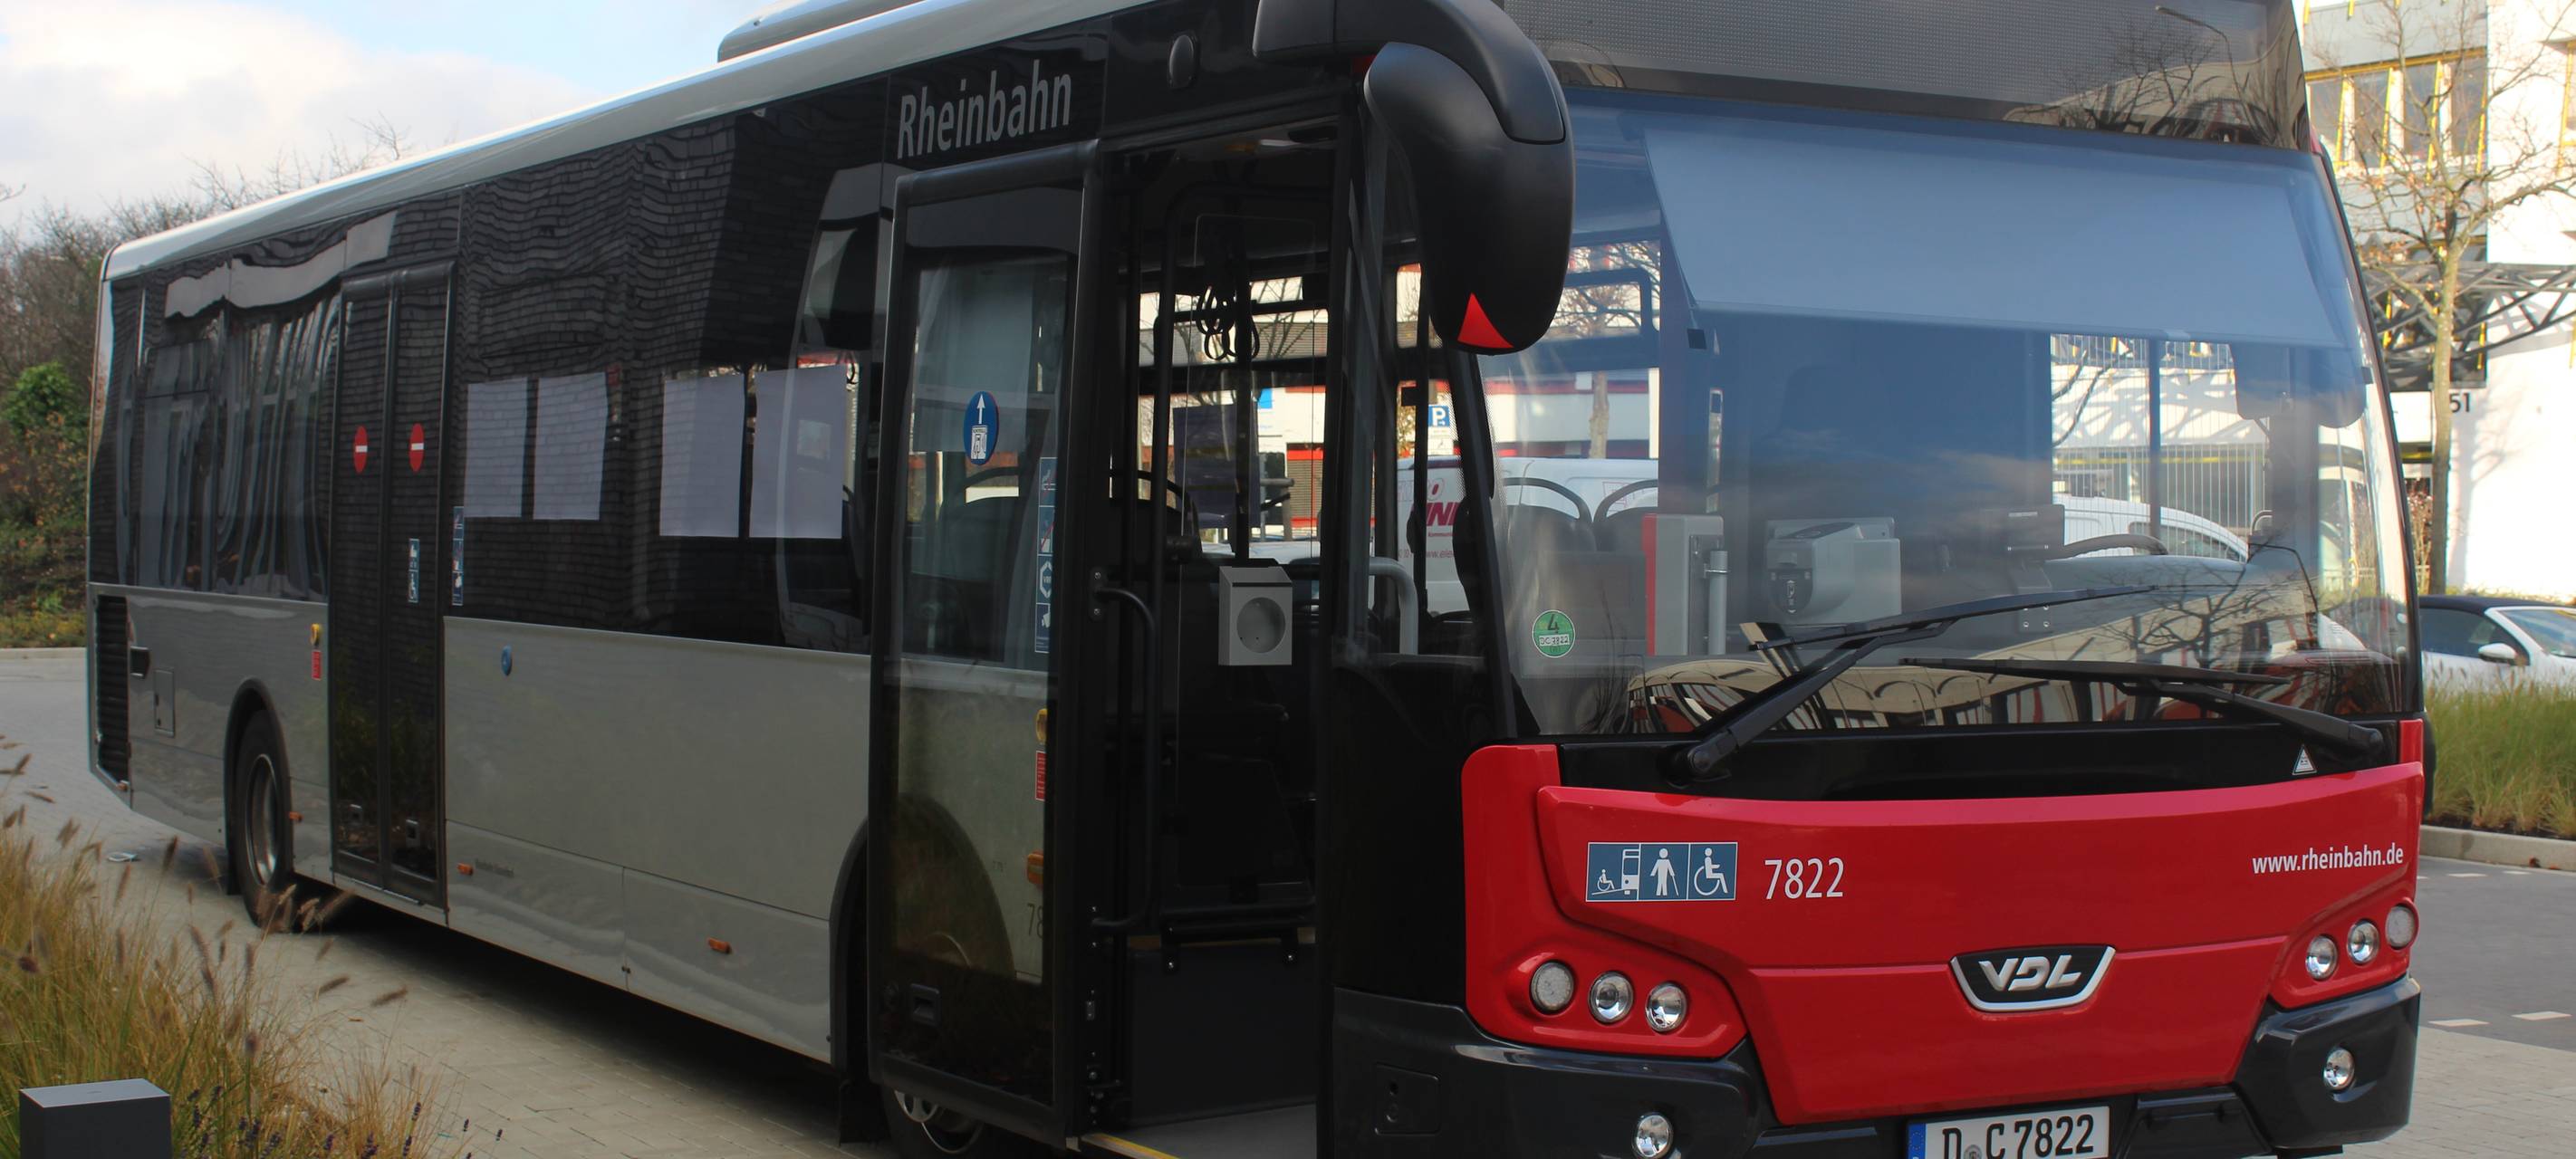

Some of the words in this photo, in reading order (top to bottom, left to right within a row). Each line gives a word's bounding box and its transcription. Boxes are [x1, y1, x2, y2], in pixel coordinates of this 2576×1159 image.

[898, 59, 1072, 159] Rheinbahn
[1432, 407, 1447, 427] P
[2448, 392, 2470, 413] 51
[1548, 613, 1560, 634] 4
[2252, 842, 2404, 875] www.rheinbahn.de
[1764, 857, 1844, 900] 7822
[1978, 954, 2082, 991] VDL
[1942, 1127, 1962, 1159] D
[1986, 1123, 2005, 1159] C
[2014, 1114, 2094, 1159] 7822
